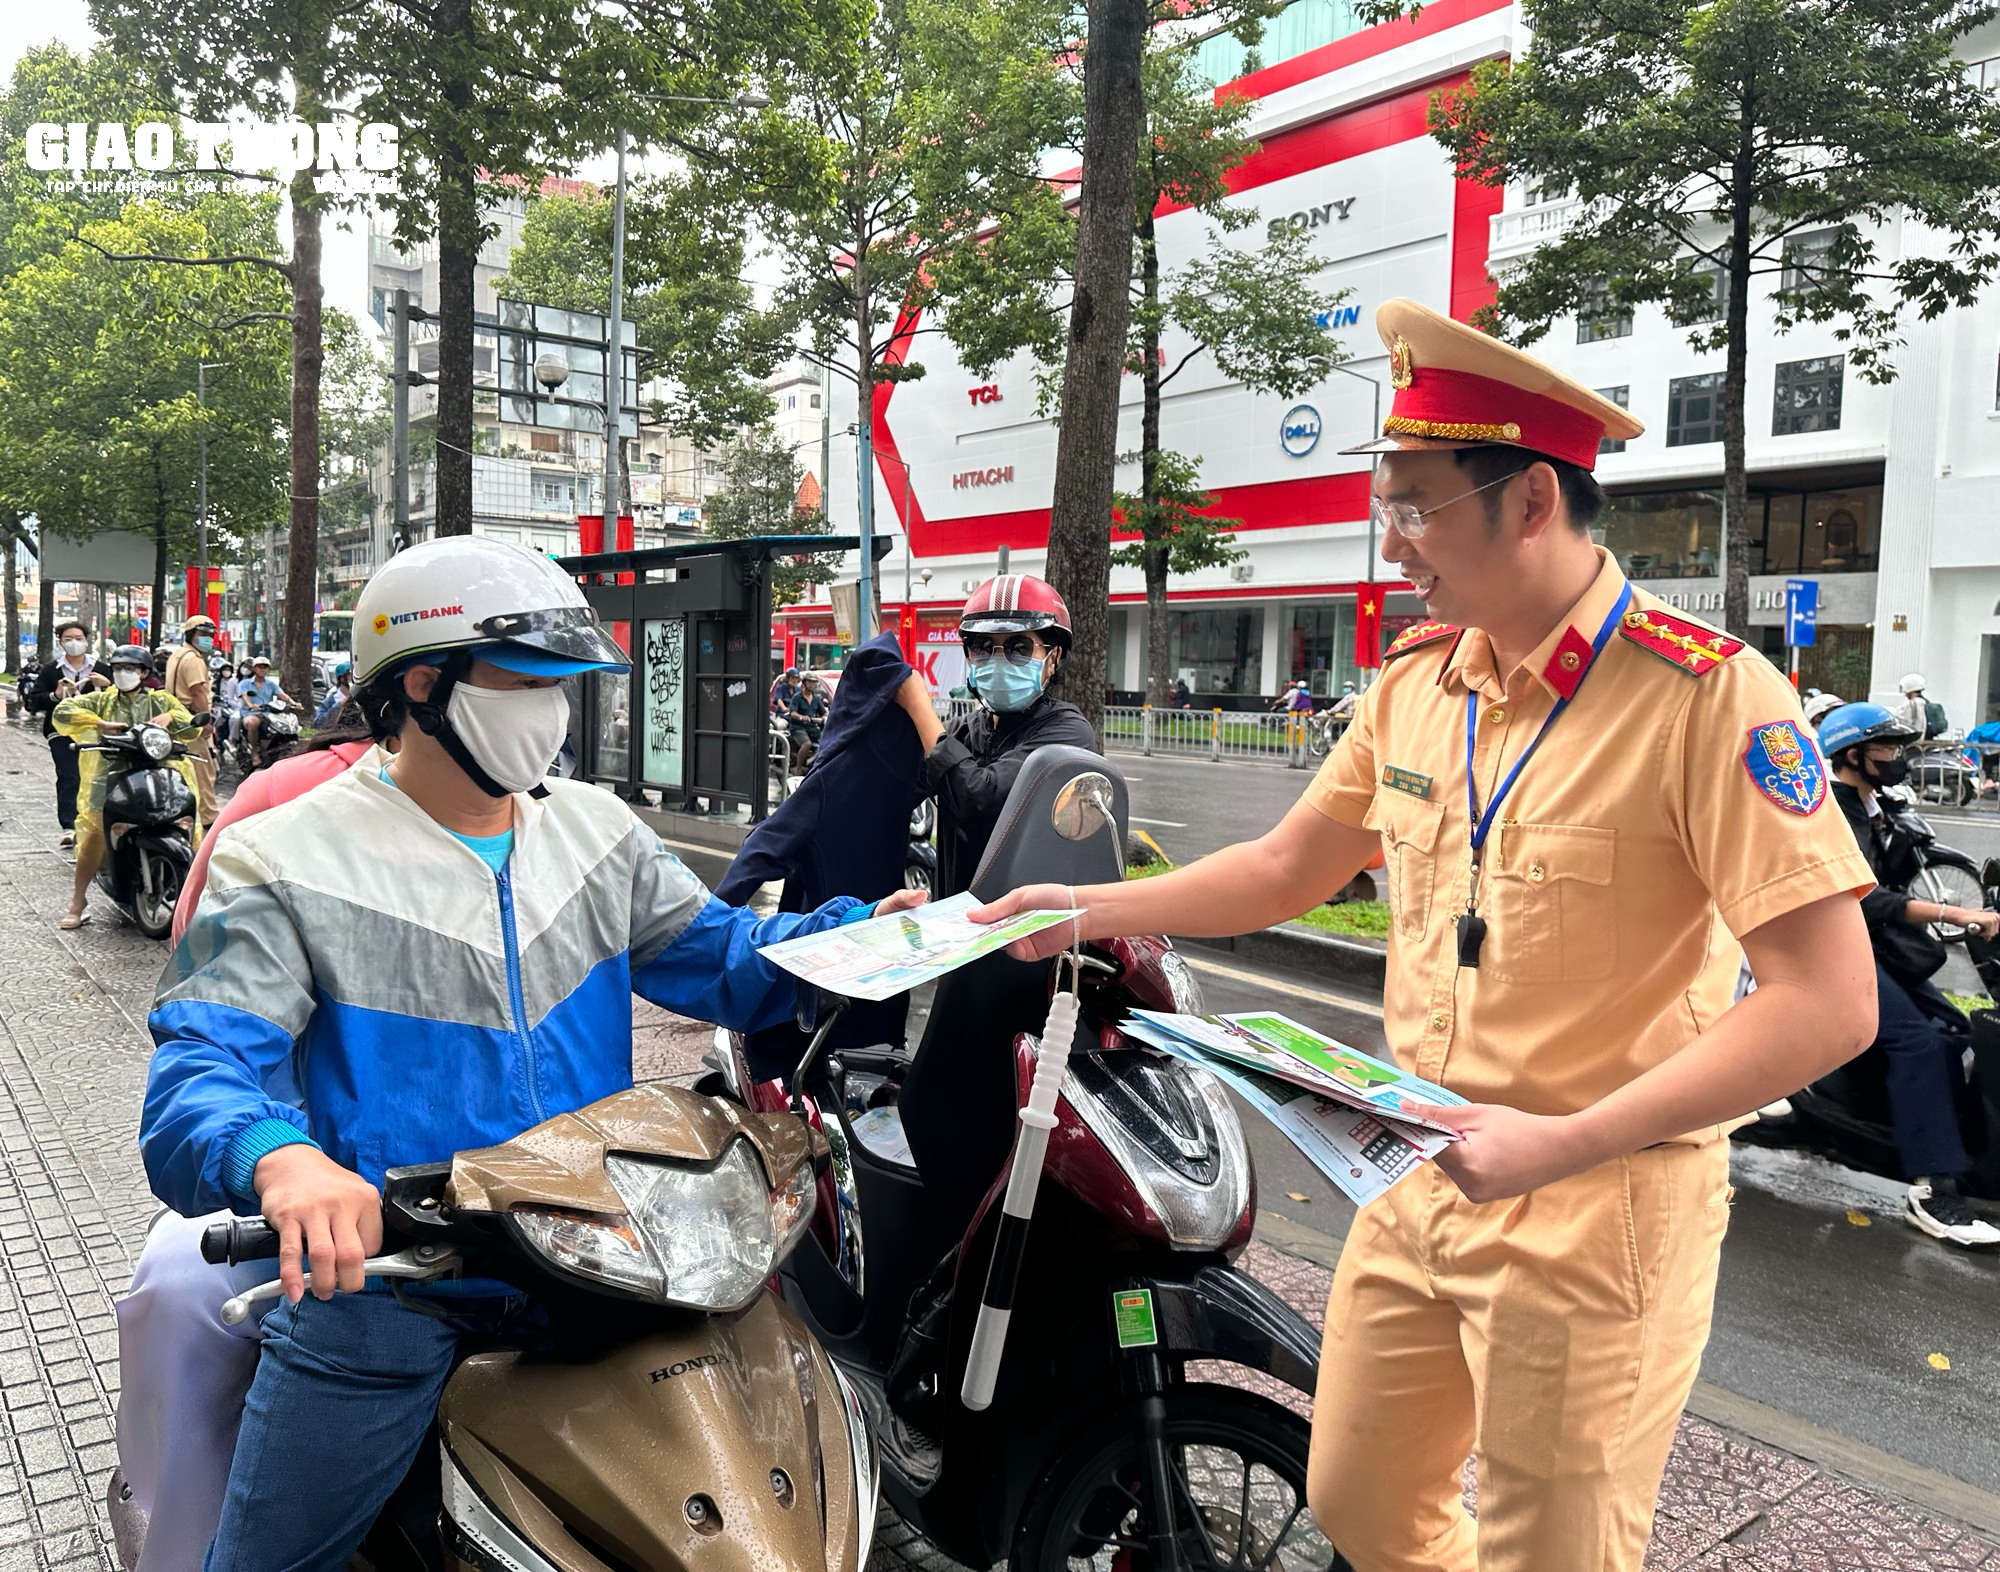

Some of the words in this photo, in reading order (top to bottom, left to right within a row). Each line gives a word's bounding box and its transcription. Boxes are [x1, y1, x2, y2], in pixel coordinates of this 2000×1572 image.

[1267, 197, 1356, 241] SONY
[1311, 304, 1361, 329] KIN
[968, 384, 1003, 406] TCL
[1286, 423, 1317, 441] DELL
[952, 465, 1014, 490] HITACHI
[1695, 591, 1726, 611] NA
[1756, 590, 1827, 610] HOL
[390, 605, 465, 626] VIETBANK
[928, 629, 943, 642] GIÁ
[1765, 765, 1819, 788] CSGT
[648, 1352, 731, 1385] HONDA
